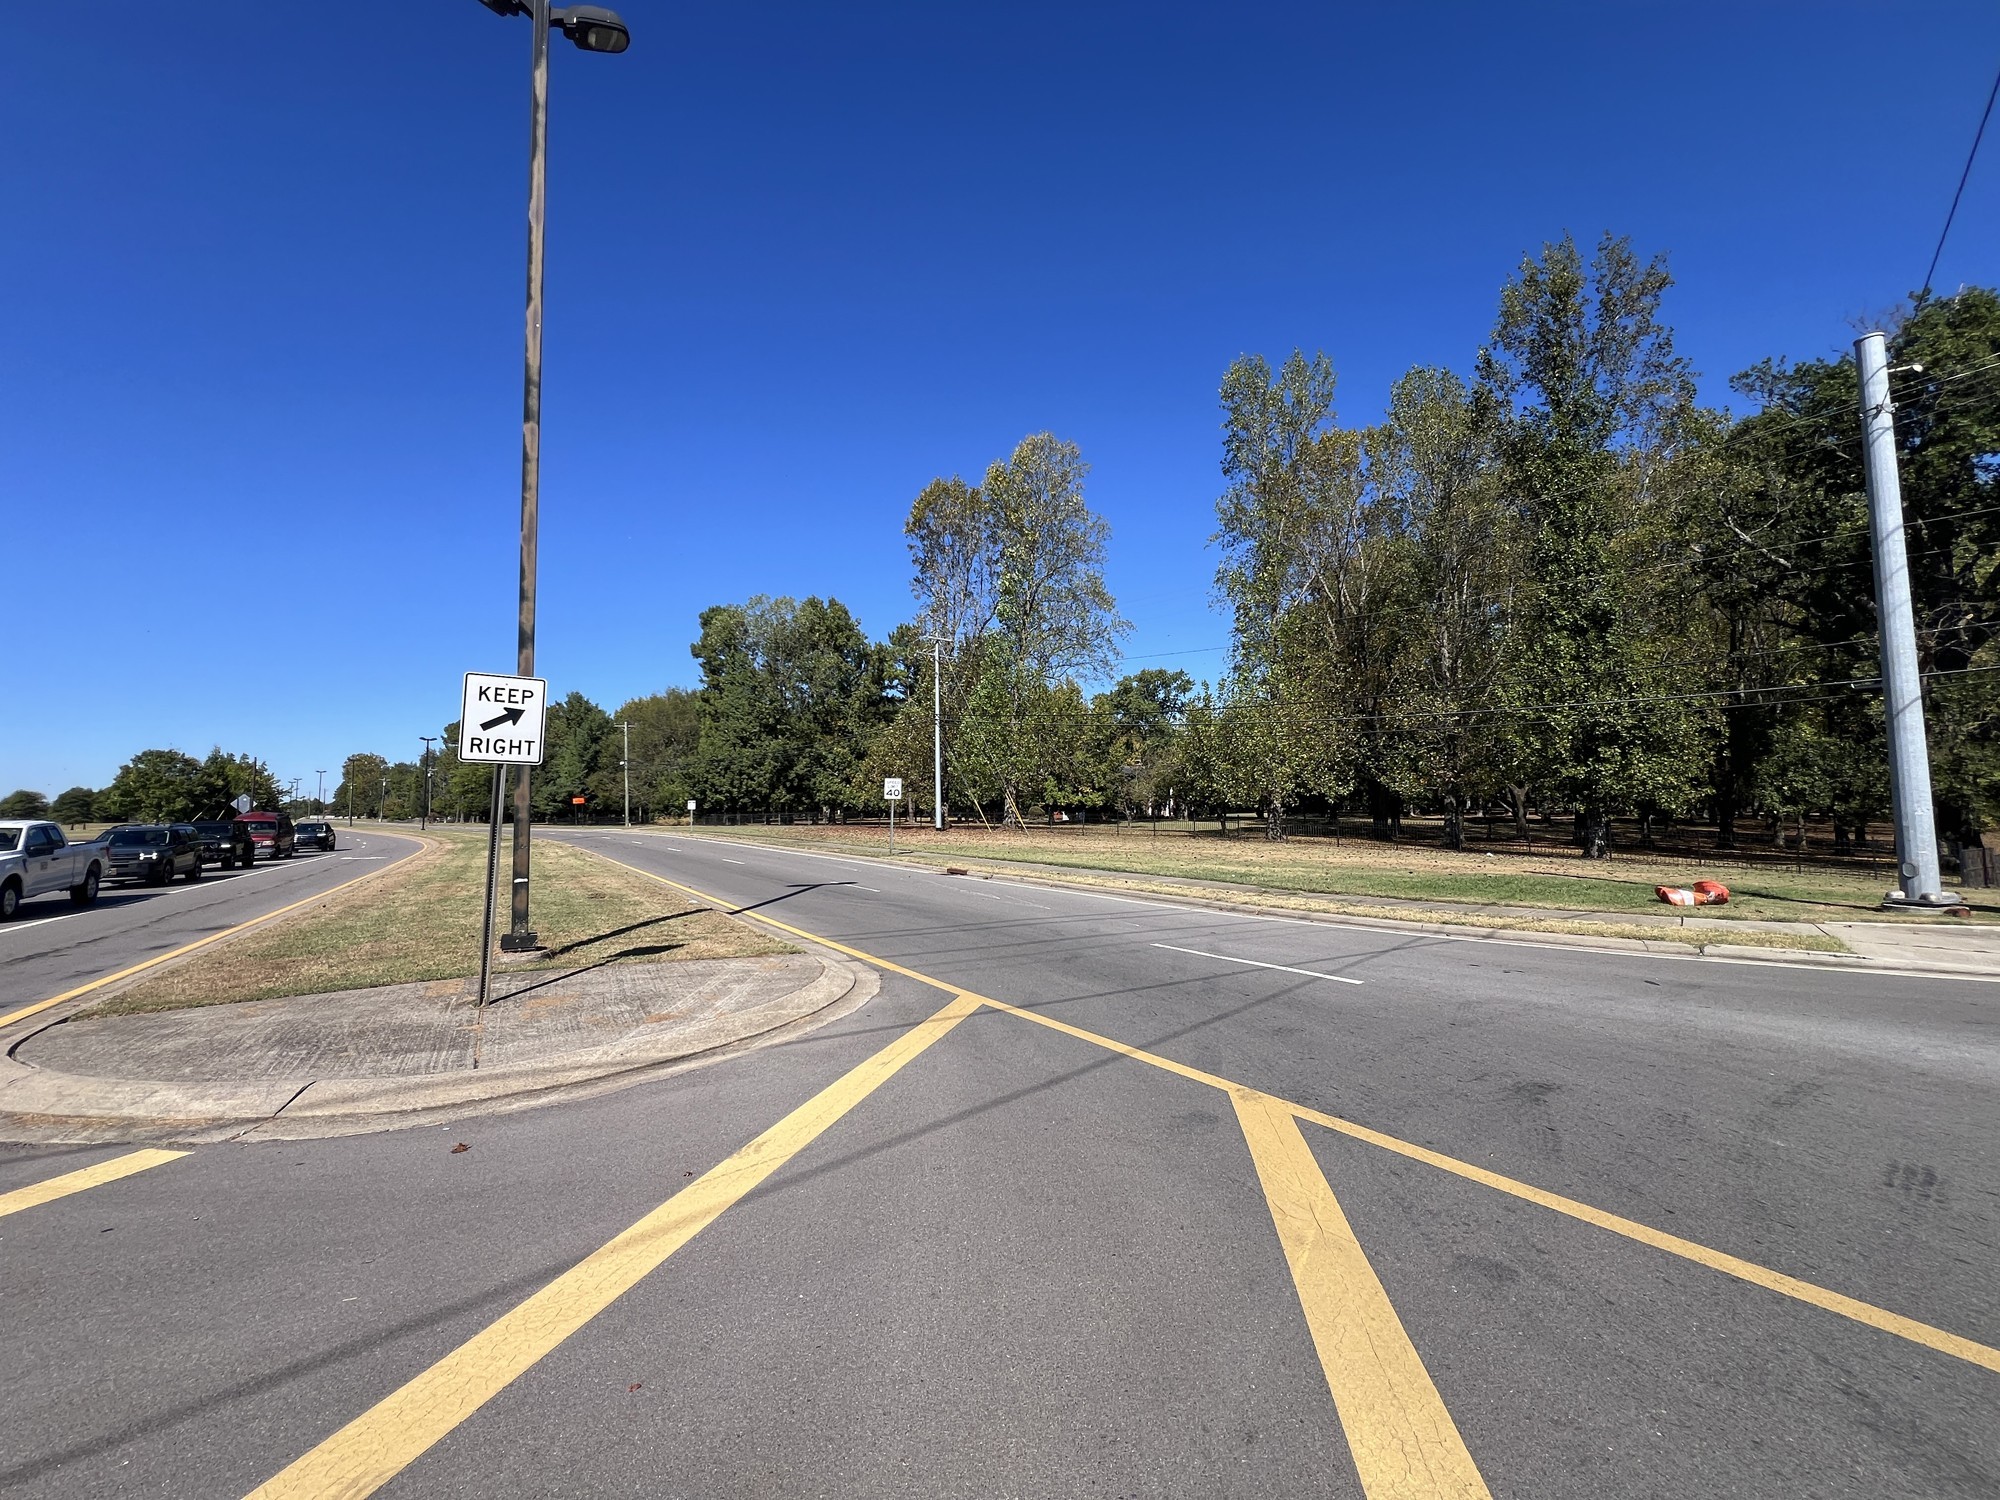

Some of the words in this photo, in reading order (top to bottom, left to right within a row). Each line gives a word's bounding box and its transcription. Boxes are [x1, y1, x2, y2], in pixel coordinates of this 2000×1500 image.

[478, 686, 534, 704] KEEP
[470, 737, 535, 755] RIGHT
[886, 789, 900, 797] 40
